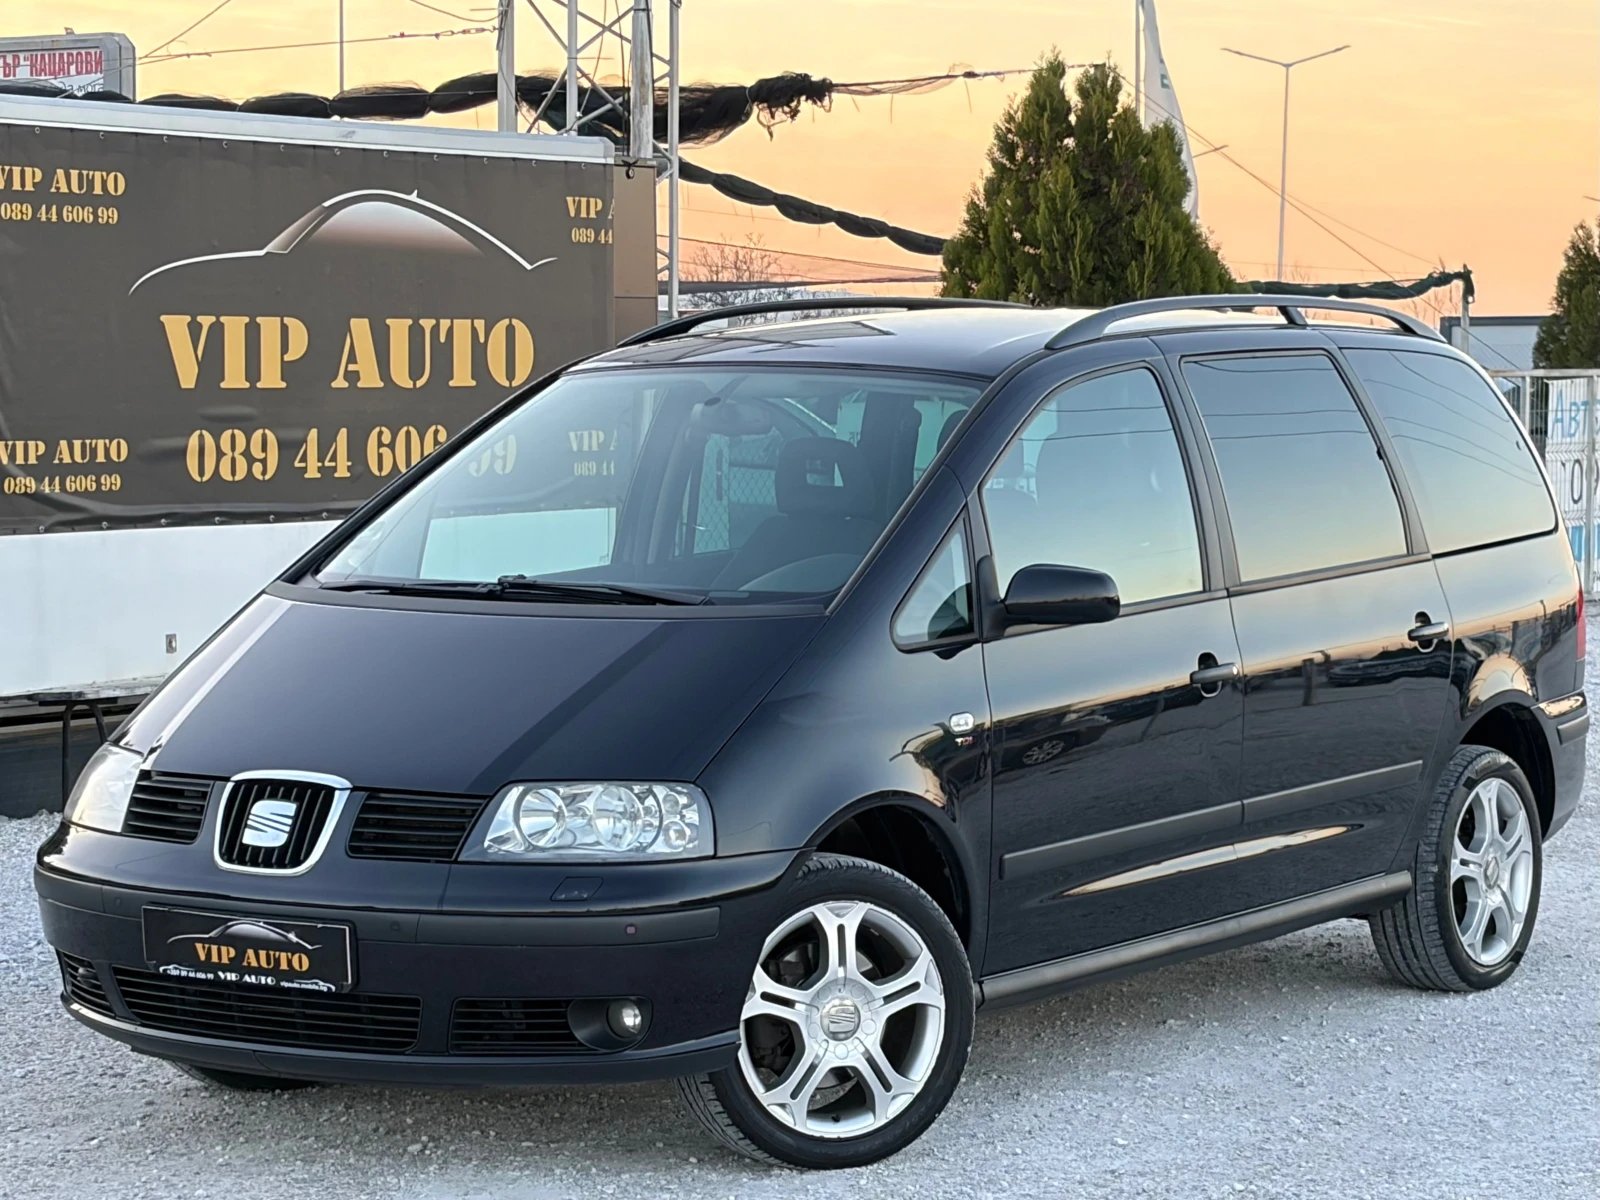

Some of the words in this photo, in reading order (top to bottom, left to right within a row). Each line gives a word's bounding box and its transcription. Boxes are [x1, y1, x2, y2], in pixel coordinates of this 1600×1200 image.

[0, 166, 42, 191] VIP
[50, 169, 126, 196] AUTO
[1, 202, 32, 220] 089
[37, 204, 57, 222] 44
[62, 206, 93, 224] 606
[98, 207, 118, 224] 99
[566, 196, 603, 219] VIP
[571, 227, 595, 243] 089
[598, 229, 613, 244] 44
[160, 314, 309, 389] VIP
[331, 317, 535, 388] AUTO
[0, 440, 46, 465] VIP
[53, 438, 128, 464] AUTO
[568, 430, 605, 452] VIP
[186, 428, 279, 482] 089
[294, 427, 351, 478] 44
[4, 476, 36, 494] 089
[40, 476, 61, 493] 44
[65, 474, 97, 492] 606
[100, 473, 121, 491] 99
[194, 942, 236, 964] VIP
[242, 948, 310, 972] AUTO
[218, 971, 240, 981] VIP
[242, 974, 276, 985] AUTO
